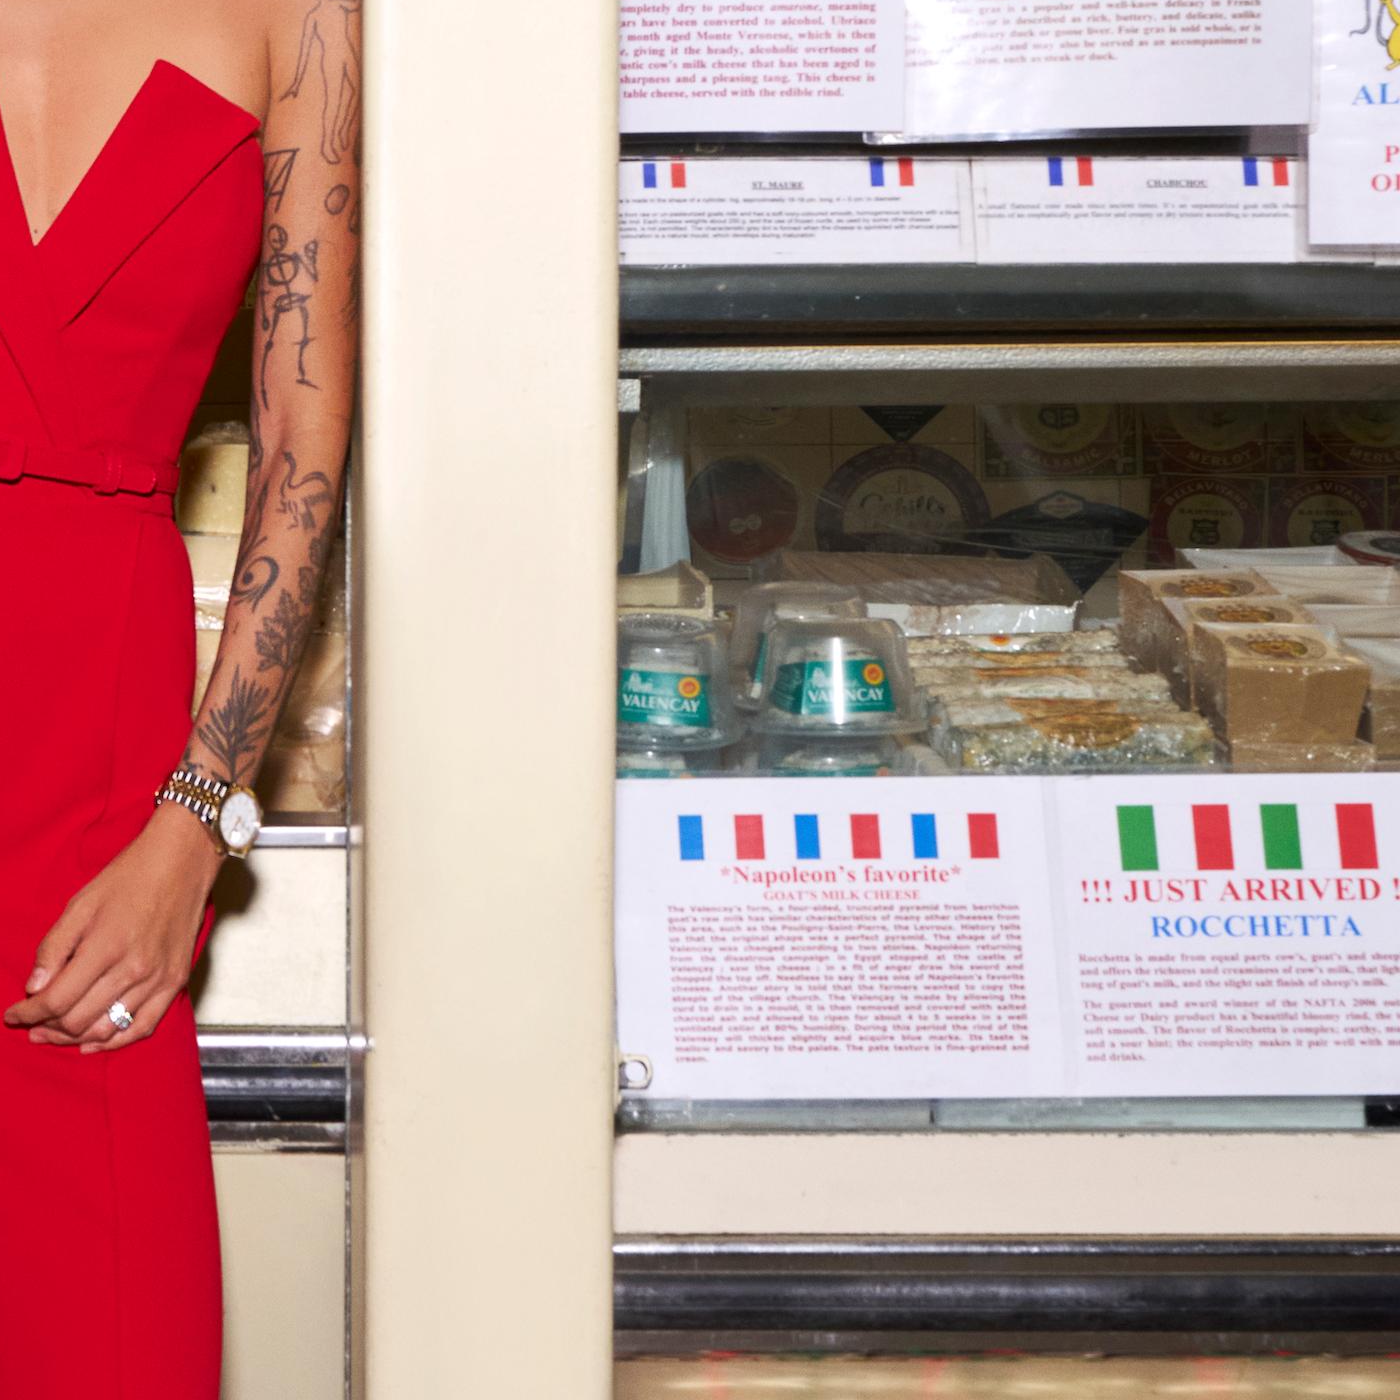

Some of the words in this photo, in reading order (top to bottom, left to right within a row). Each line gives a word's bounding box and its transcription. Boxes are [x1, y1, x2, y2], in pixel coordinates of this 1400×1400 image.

[622, 89, 648, 98] table
[690, 88, 727, 97] served
[730, 88, 755, 96] with
[758, 87, 776, 96] the
[1186, 448, 1254, 468] MERLOT
[621, 693, 699, 714] VALENCAY
[807, 687, 885, 703] VANCAY
[764, 889, 818, 901] GOAT'S
[823, 889, 860, 901] MILK
[864, 889, 921, 901] CHEESE
[1124, 878, 1207, 903] JUST
[1220, 877, 1381, 902] ARRIVED
[1152, 915, 1362, 938] ROCCHETTA
[1181, 979, 1202, 987] and
[1204, 979, 1221, 987] the
